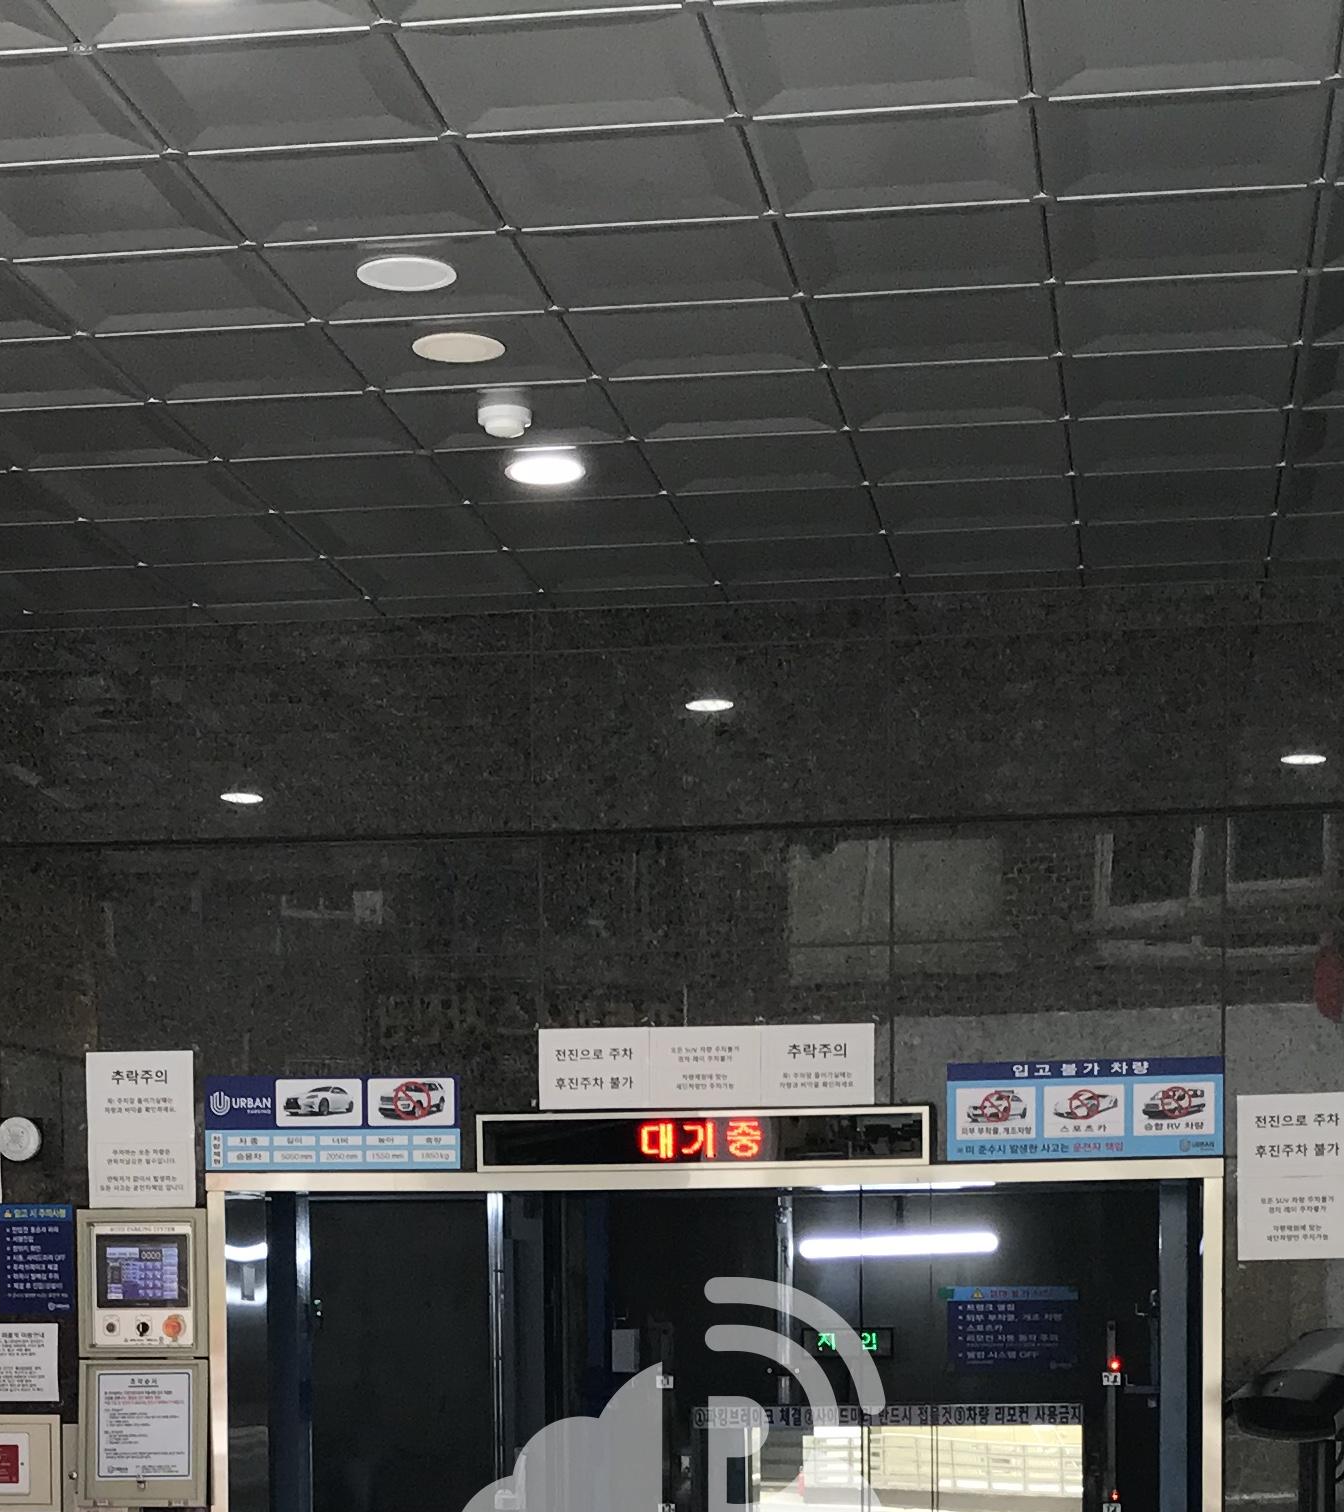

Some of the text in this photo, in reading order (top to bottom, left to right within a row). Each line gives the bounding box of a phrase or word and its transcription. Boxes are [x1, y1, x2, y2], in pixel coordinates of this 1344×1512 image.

[555, 1047, 633, 1062] 전진으로 주차
[787, 1042, 847, 1060] 추락주의
[1013, 1061, 1150, 1077] 입고 불가 차량
[111, 1069, 168, 1085] 추락주의
[555, 1076, 634, 1090] 후진주차 불가
[232, 1097, 272, 1109] URBAN
[1185, 1122, 1204, 1130] 차량
[1255, 1113, 1340, 1128] 전진으로 주차
[1061, 1124, 1107, 1134] 스포츠카
[640, 1119, 761, 1158] 대기중
[1040, 1143, 1069, 1153] 사고는
[1255, 1142, 1340, 1158] 후진주차 불가
[779, 1408, 801, 1426] 체결
[995, 1404, 1030, 1425] 리모컨
[1034, 1403, 1082, 1425] 사용금지
